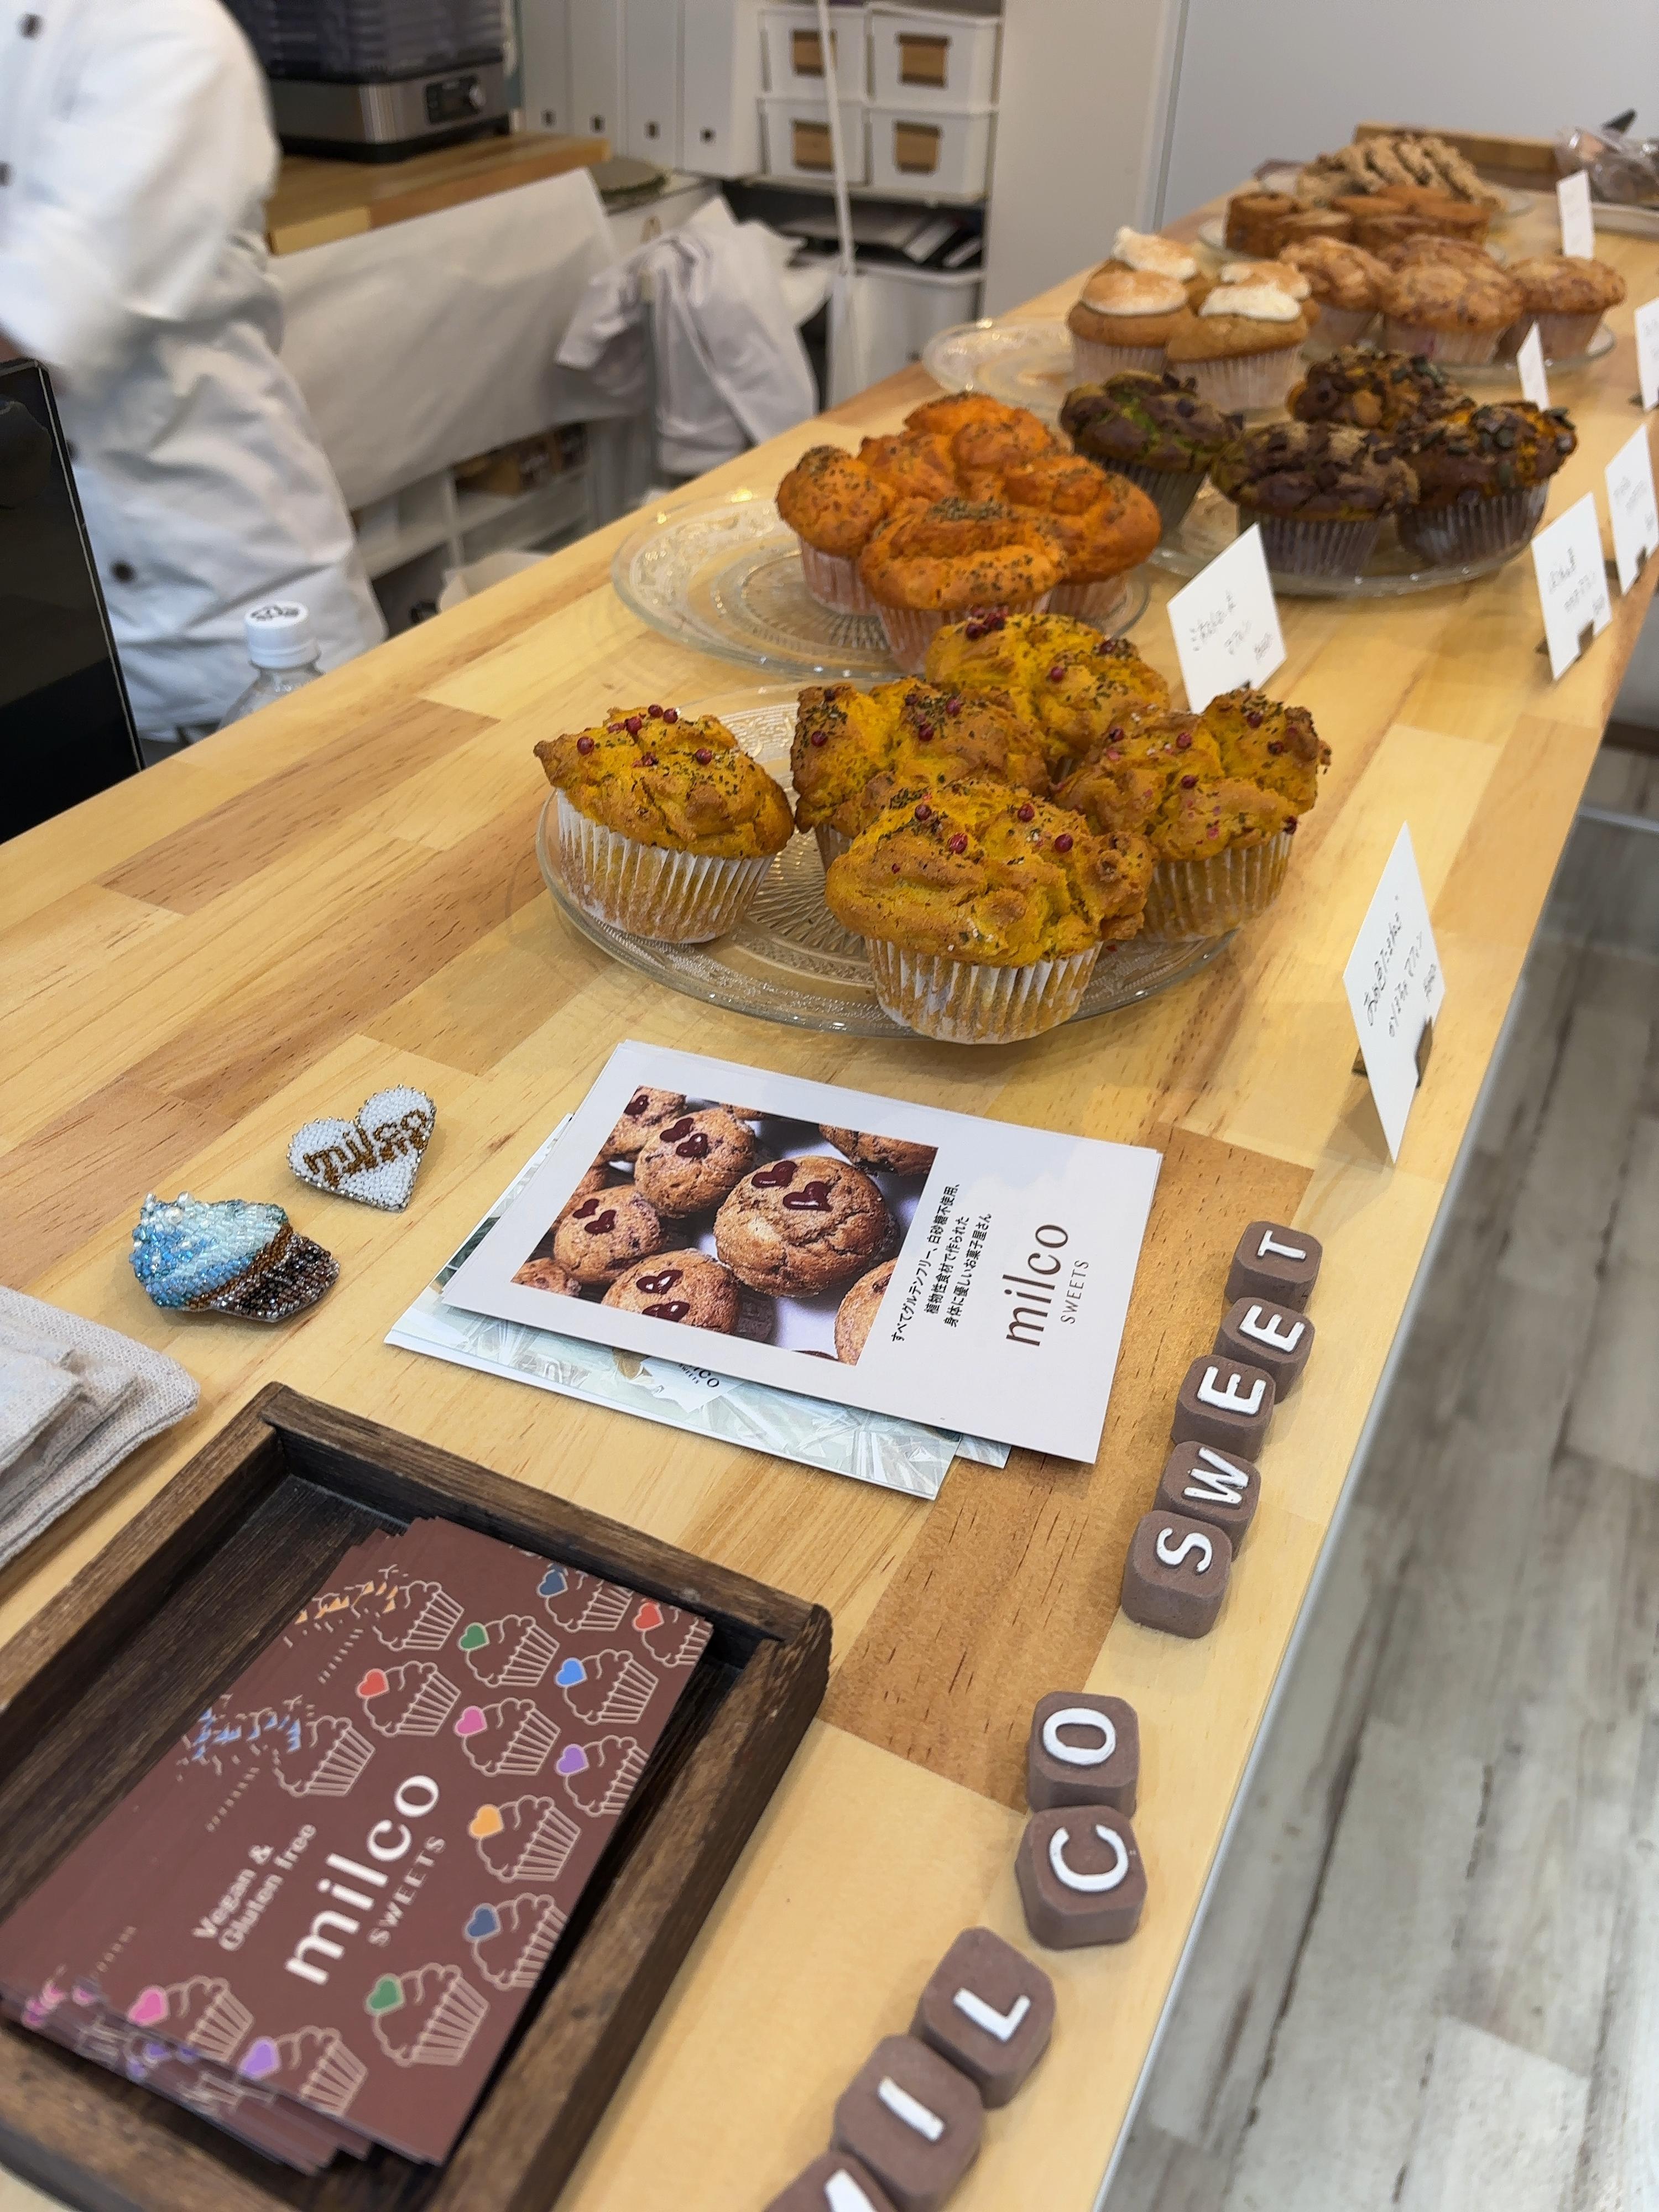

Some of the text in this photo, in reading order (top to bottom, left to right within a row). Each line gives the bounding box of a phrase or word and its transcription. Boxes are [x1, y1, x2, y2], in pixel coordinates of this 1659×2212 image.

[923, 1216, 969, 1316] 植物性食材で作られた
[943, 1213, 992, 1328] 身体に優しいお菓子屋さん
[1002, 1224, 1068, 1347] milco
[1060, 1259, 1089, 1324] SWEETS
[823, 1229, 1307, 2212] ILCO SWEET
[248, 1843, 274, 1866] &
[284, 1774, 440, 1986] milco
[367, 1835, 447, 1947] SWEETS
